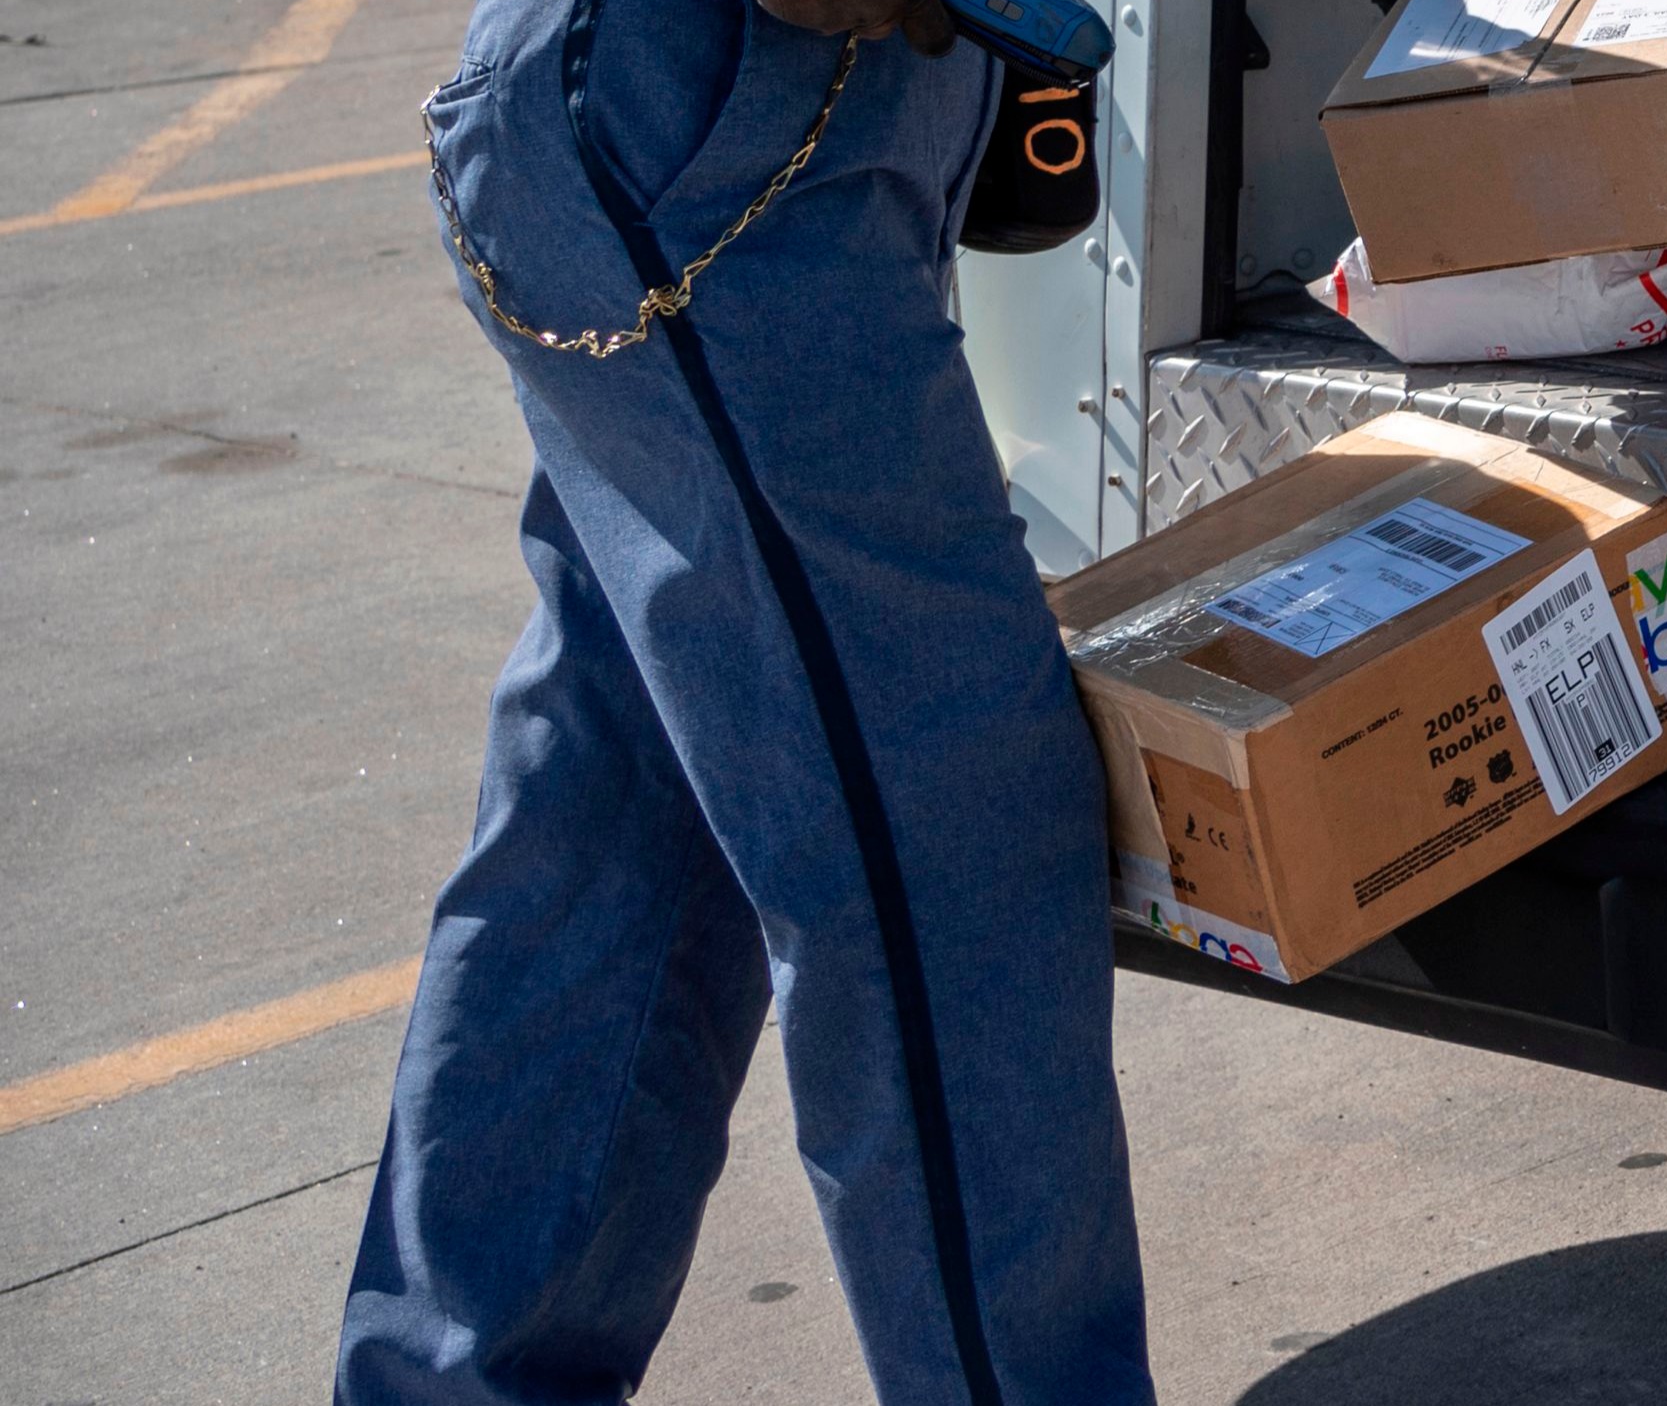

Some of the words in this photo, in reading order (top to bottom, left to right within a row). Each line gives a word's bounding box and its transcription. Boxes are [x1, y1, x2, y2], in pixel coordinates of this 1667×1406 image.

[1581, 602, 1596, 622] ELP
[1545, 650, 1596, 705] ELP
[1424, 683, 1506, 742] 2005-0
[1575, 693, 1586, 708] P
[1321, 729, 1366, 759] CONTENT:
[1428, 714, 1506, 769] Rookie
[1598, 744, 1613, 758] 31
[1588, 743, 1633, 782] 79912
